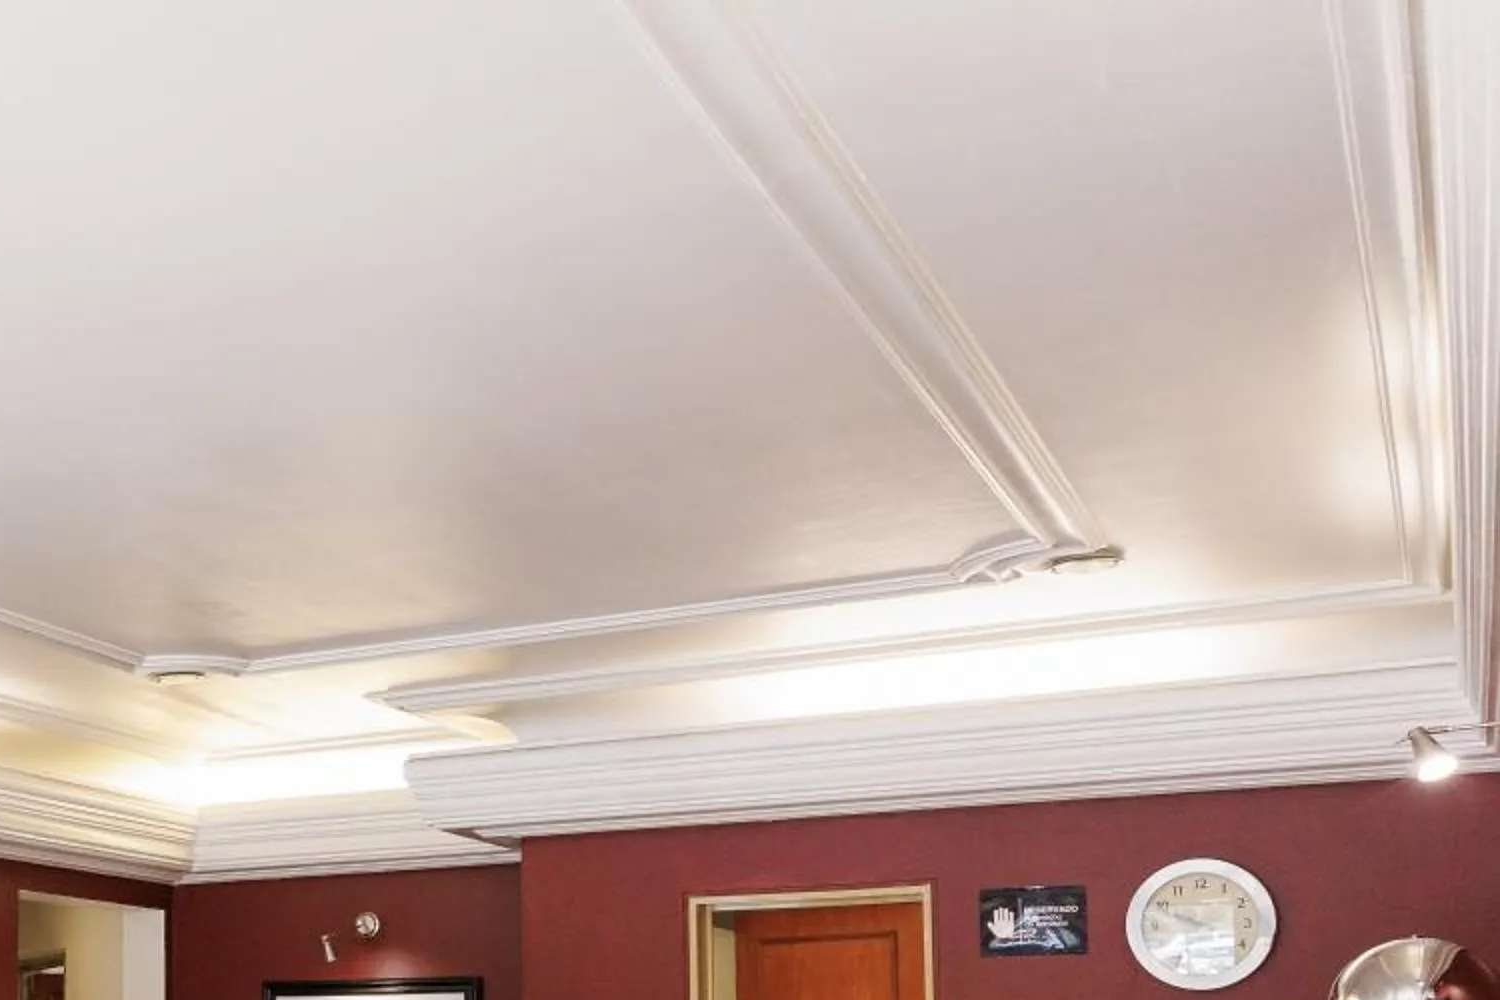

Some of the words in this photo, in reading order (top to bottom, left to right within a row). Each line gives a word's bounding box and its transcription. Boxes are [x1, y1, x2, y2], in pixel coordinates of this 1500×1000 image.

[1195, 878, 1208, 889] 12
[1172, 886, 1183, 896] 11
[1237, 897, 1246, 909] 2
[1023, 905, 1079, 914] ERVADO
[1243, 917, 1252, 929] 3
[1237, 939, 1246, 950] 4
